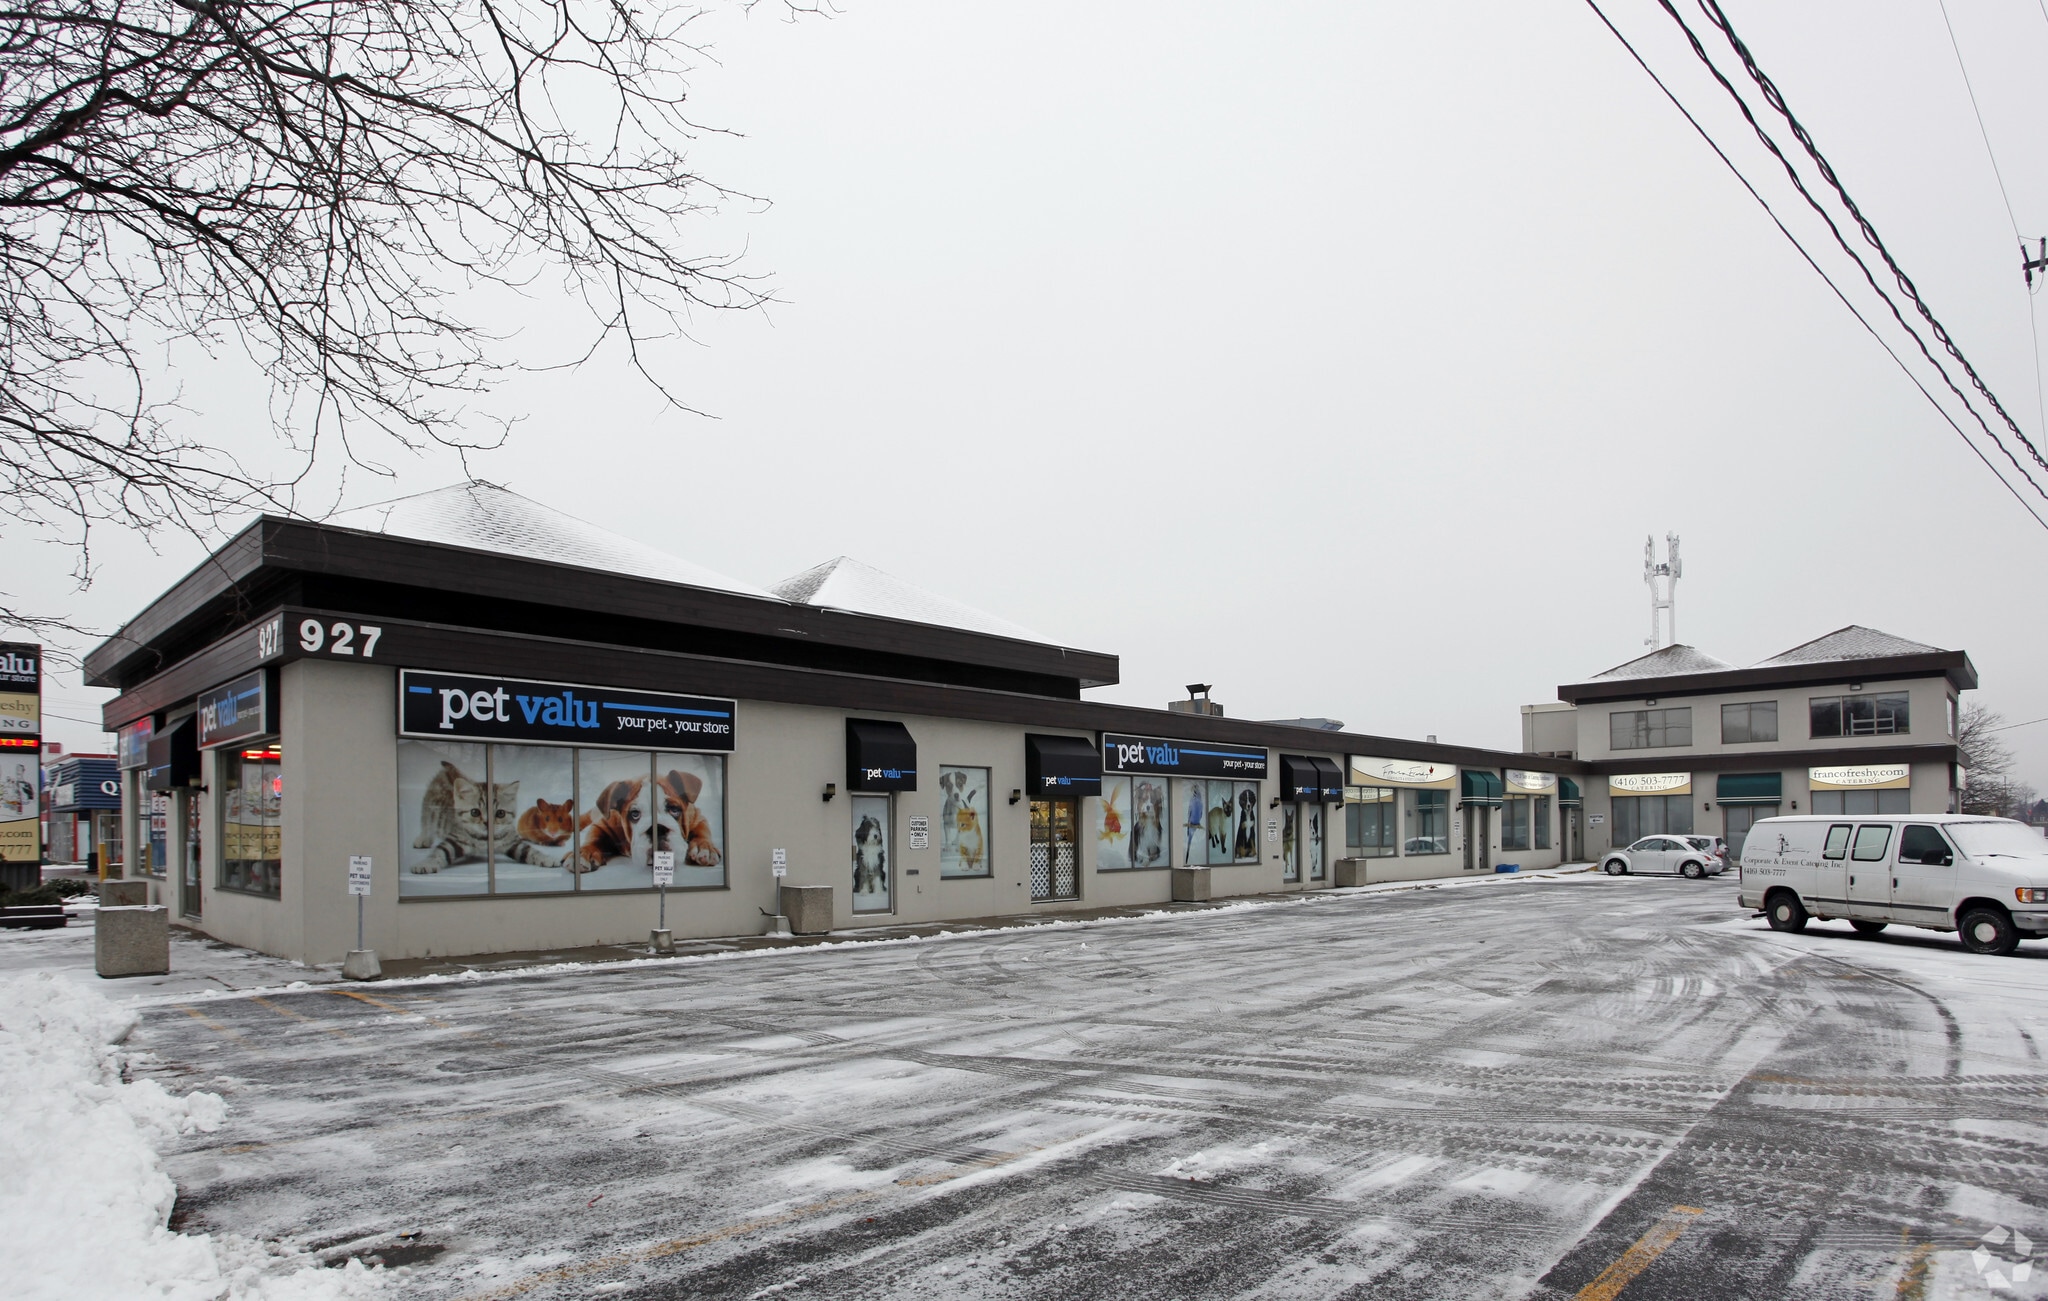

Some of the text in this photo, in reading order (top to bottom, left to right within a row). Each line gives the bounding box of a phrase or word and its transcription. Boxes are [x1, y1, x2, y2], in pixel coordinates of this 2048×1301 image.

[259, 619, 279, 659] 927
[300, 618, 382, 658] 927
[0, 699, 35, 715] eshy
[439, 686, 600, 730] pet valu
[3, 719, 30, 729] NG
[202, 698, 217, 742] pet
[617, 716, 730, 734] your pet your store
[1117, 741, 1179, 769] pet valu
[1223, 760, 1265, 770] your pet your store
[867, 767, 902, 780] pet valu
[1045, 776, 1071, 786] pet valu
[1614, 775, 1685, 787] (416) 503-7777
[1813, 767, 1904, 780] francofreshy.com
[101, 780, 122, 796] Q
[1743, 856, 1771, 865] Corporate
[1800, 858, 1829, 868] Catering
[1831, 860, 1844, 868] Inc.
